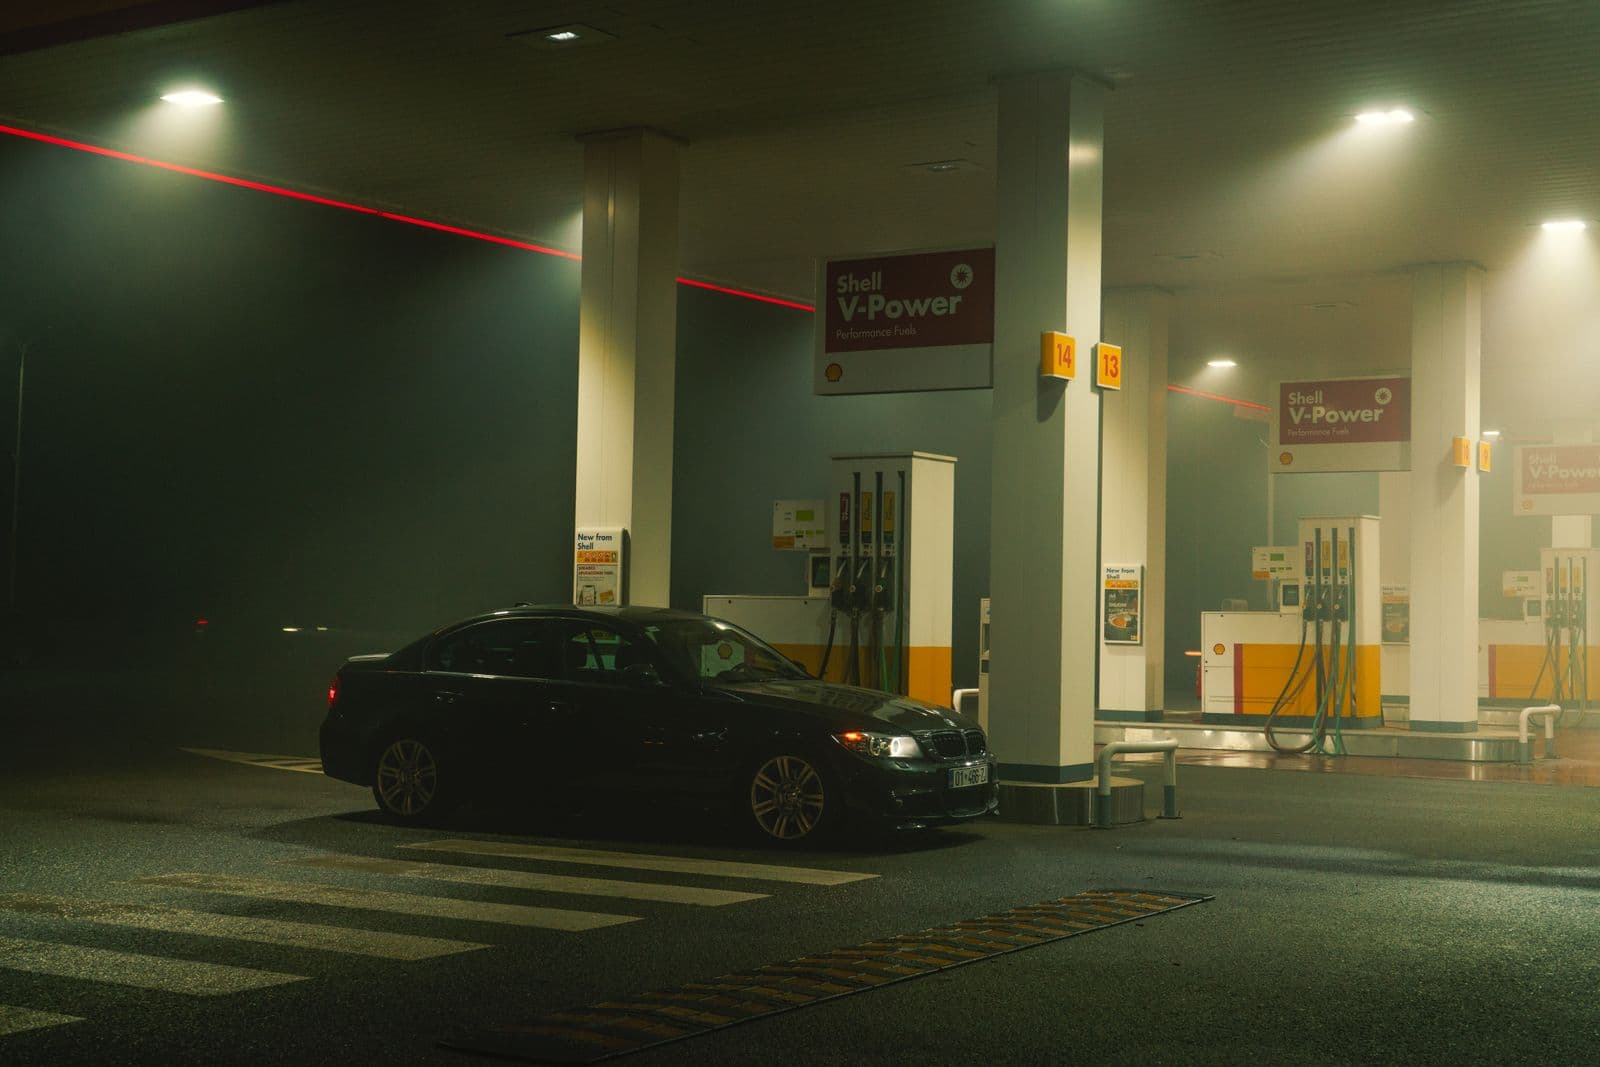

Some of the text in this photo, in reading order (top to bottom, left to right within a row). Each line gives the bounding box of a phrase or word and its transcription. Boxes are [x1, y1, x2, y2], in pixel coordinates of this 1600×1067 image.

[837, 271, 882, 294] Shell
[837, 294, 963, 322] V-Power
[835, 324, 917, 340] Performance Fuels
[1056, 343, 1072, 369] 14
[1102, 353, 1119, 378] 13
[1288, 390, 1323, 407] Shell
[1288, 406, 1384, 426] V-Power
[1528, 451, 1557, 465] Shell
[1529, 464, 1600, 480] V-Powe
[577, 533, 613, 541] New from
[577, 542, 594, 550] Shell
